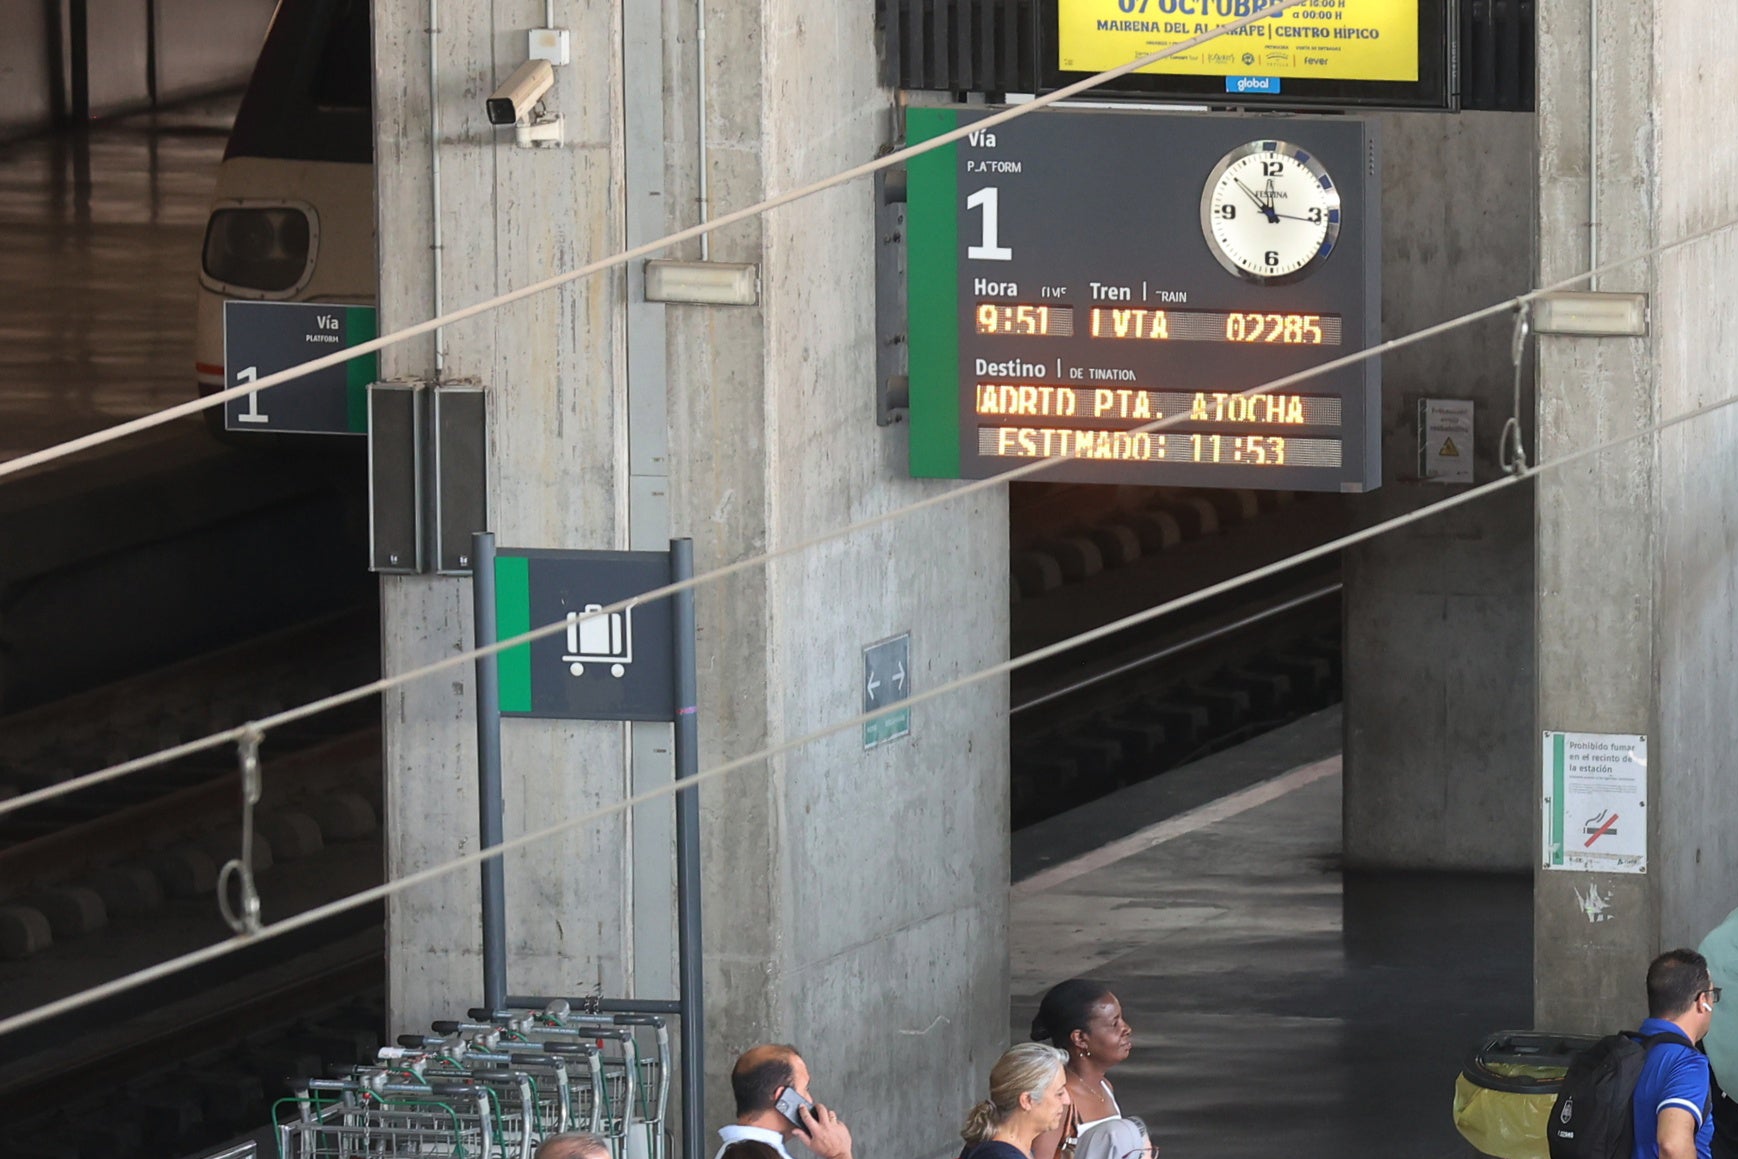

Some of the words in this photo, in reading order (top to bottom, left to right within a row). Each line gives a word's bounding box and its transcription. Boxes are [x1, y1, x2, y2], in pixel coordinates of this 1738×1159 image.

[1302, 11, 1332, 20] 00:00
[1335, 11, 1342, 20] H
[1097, 20, 1160, 33] MAIRENA
[1164, 22, 1190, 34] DEL
[1275, 26, 1330, 38] CENTRO
[1304, 56, 1328, 65] fever
[1237, 77, 1269, 91] global
[968, 129, 996, 147] Vía
[1260, 161, 1284, 177] 12
[1221, 204, 1236, 220] 9
[1308, 207, 1321, 222] 3
[967, 187, 1012, 260] 1
[1264, 251, 1279, 266] 6
[974, 278, 1018, 296] Hora
[1090, 282, 1131, 300] Tren
[317, 315, 339, 329] Vía
[1225, 312, 1323, 344] 02285
[306, 334, 339, 343] PLATFORM
[975, 358, 1046, 378] Destino
[237, 366, 269, 422] 1
[1094, 388, 1163, 420] PTA.
[1190, 392, 1304, 424] ATOCHA
[1190, 434, 1285, 465] 11:53
[1569, 741, 1608, 751] Prohibido
[1611, 743, 1635, 752] fumar
[1582, 753, 1589, 761] el
[1592, 754, 1620, 763] recinto
[1622, 755, 1633, 763] de
[1569, 764, 1577, 772] la
[1579, 764, 1613, 773] estación
